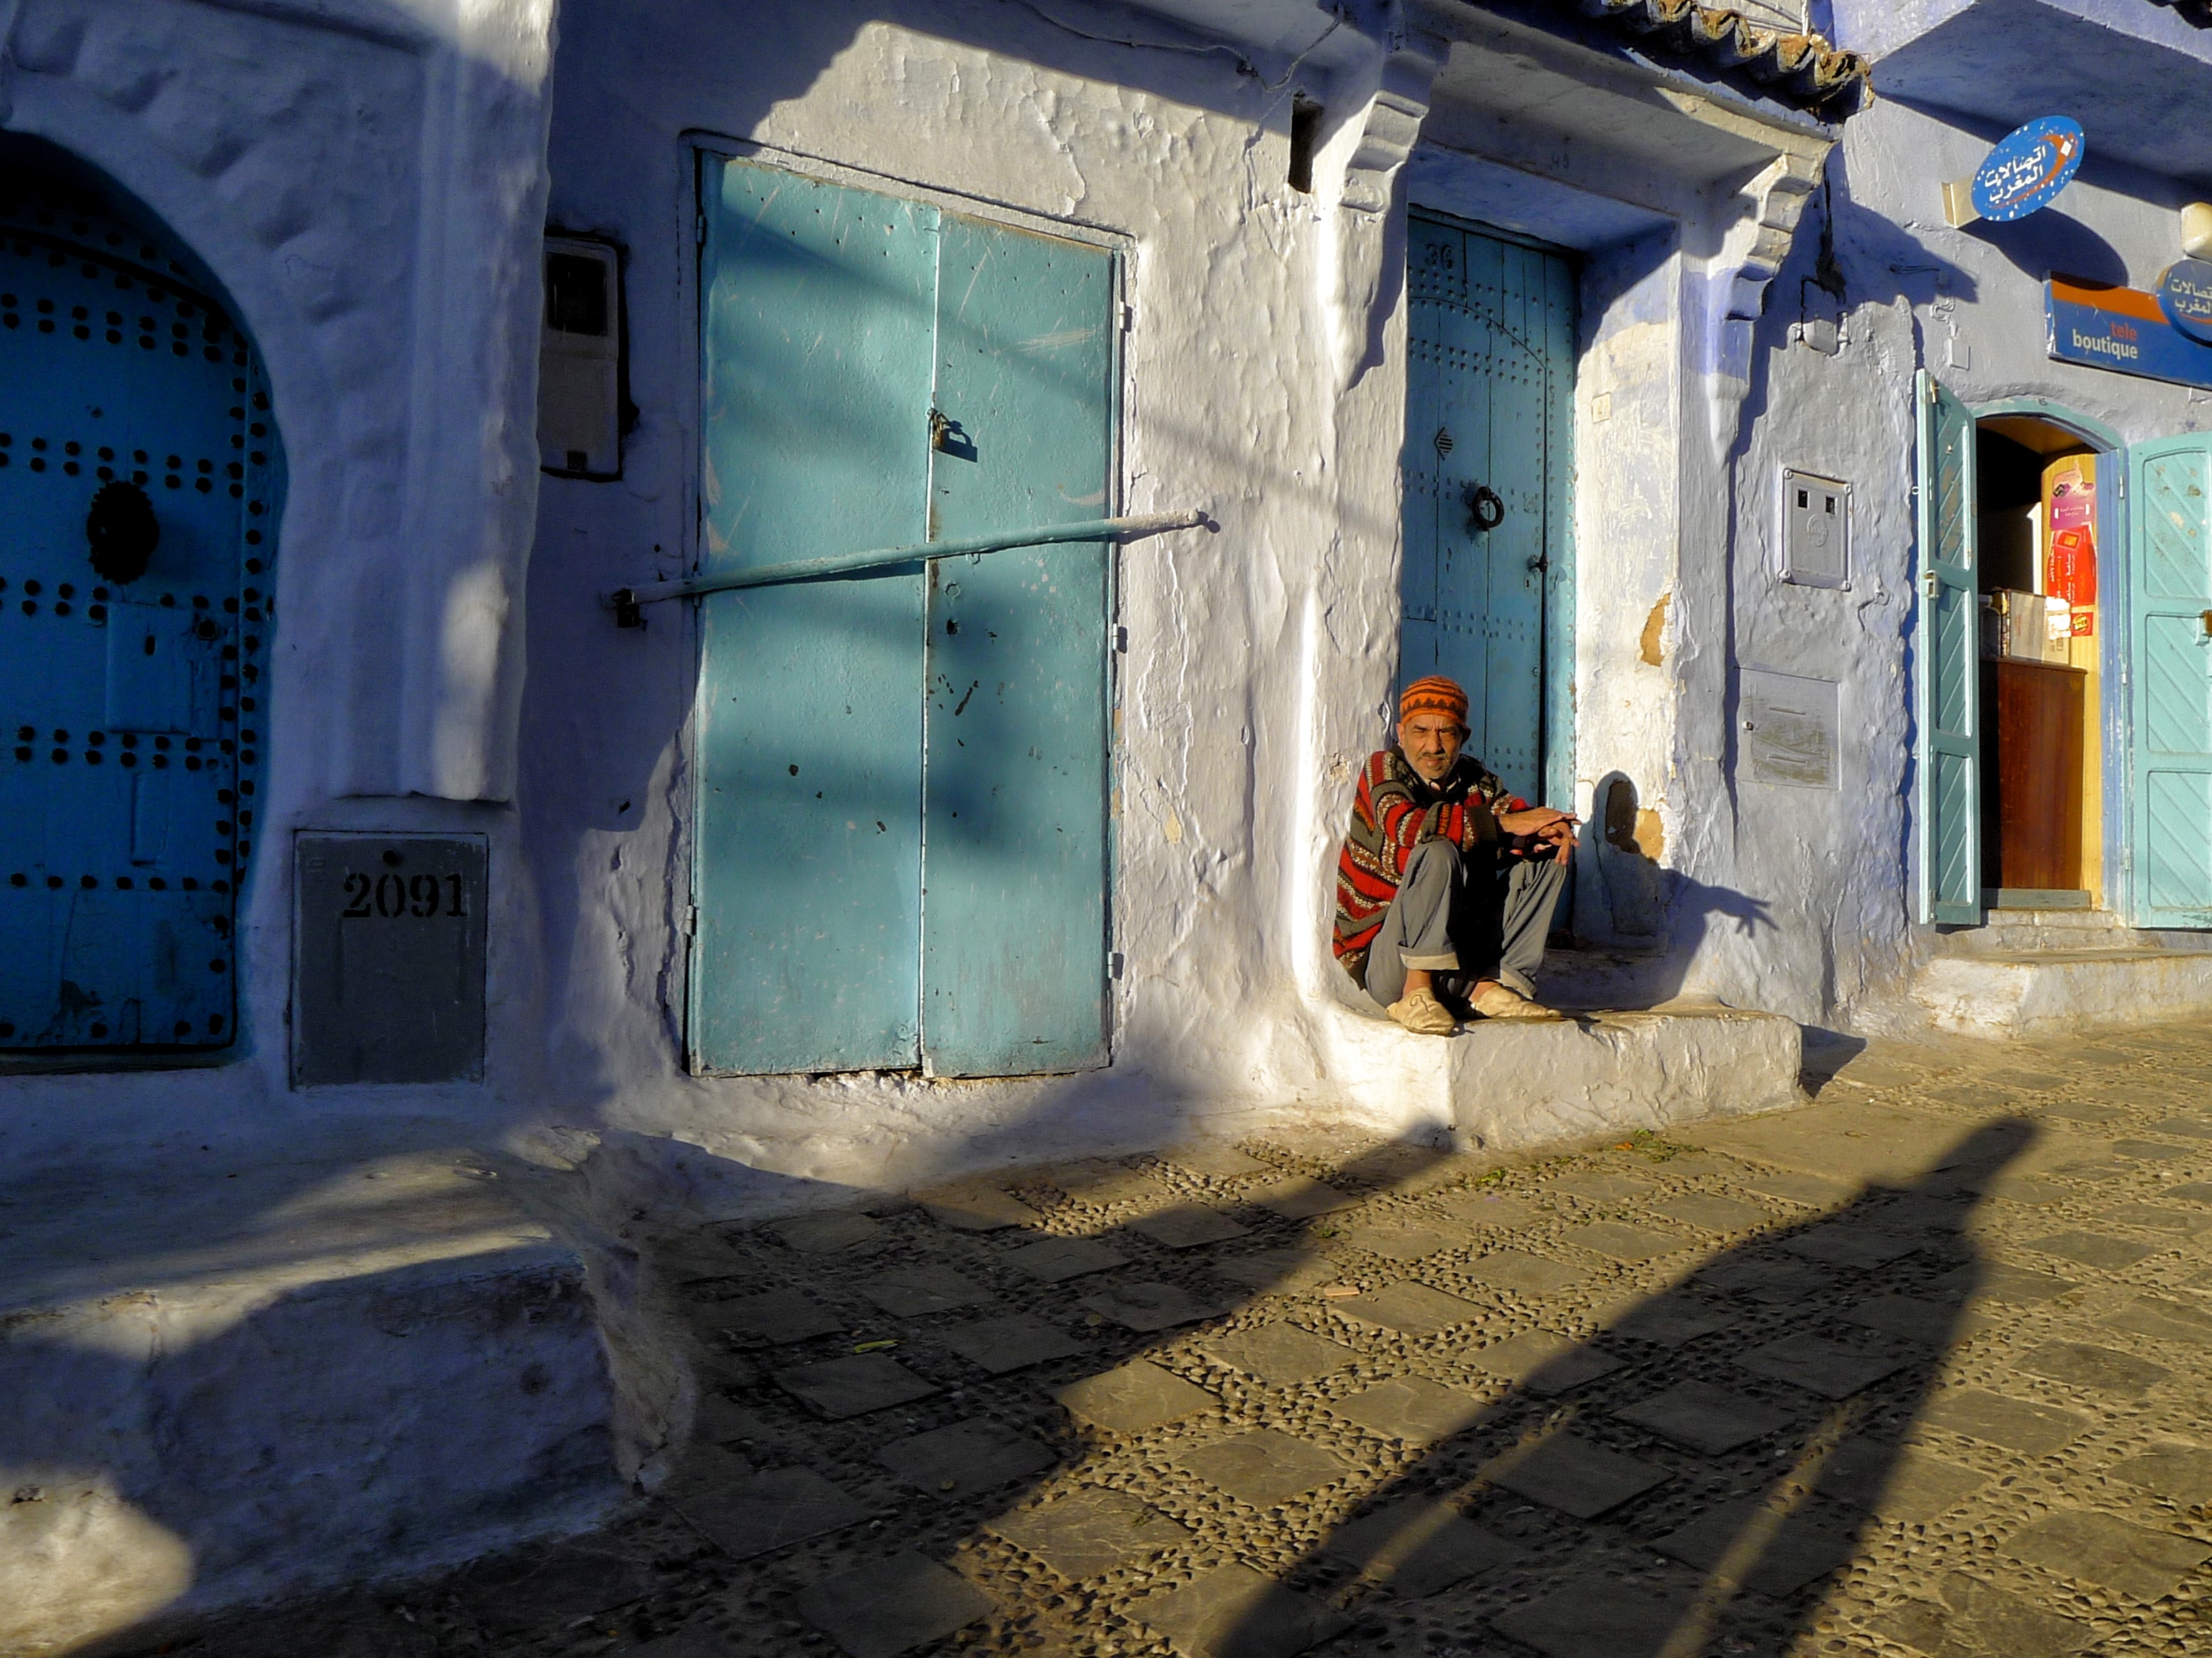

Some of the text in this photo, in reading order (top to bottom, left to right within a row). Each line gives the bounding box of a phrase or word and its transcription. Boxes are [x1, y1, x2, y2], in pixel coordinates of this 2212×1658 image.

[1985, 145, 2046, 187] اتصالات
[1990, 165, 2043, 203] المغرب
[1424, 243, 1454, 270] 36
[2171, 278, 2212, 299] تصالات
[2174, 298, 2211, 314] لمغرب
[2072, 328, 2138, 360] boutique
[2110, 320, 2137, 342] tele
[343, 873, 469, 918] 2091
